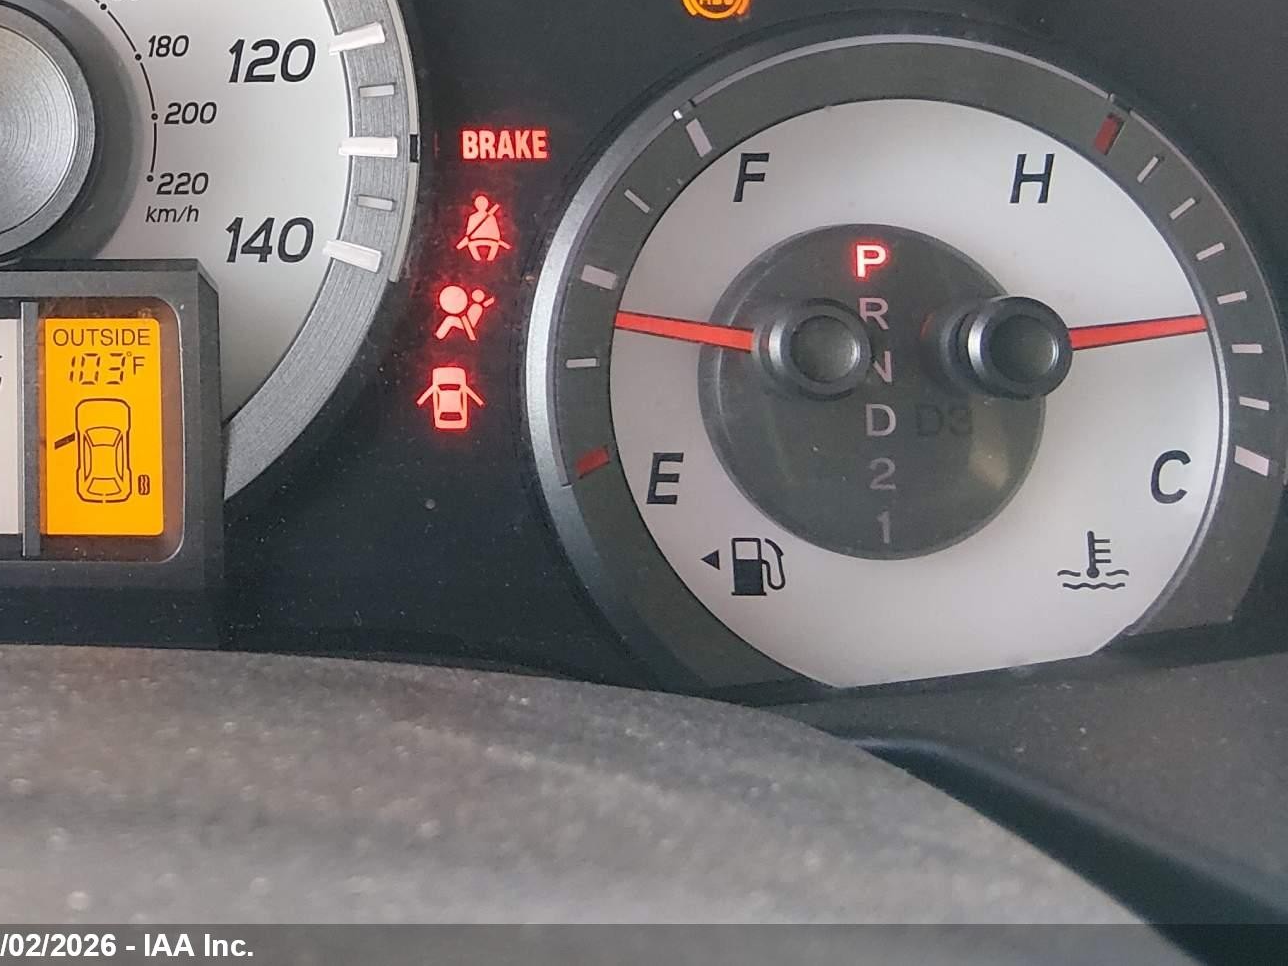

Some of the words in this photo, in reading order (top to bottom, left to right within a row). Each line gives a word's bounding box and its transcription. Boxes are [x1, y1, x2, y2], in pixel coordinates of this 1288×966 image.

[148, 35, 190, 58] 180
[228, 39, 316, 83] 120
[164, 102, 217, 125] 200
[461, 129, 549, 161] BRAKE
[156, 172, 209, 196] 220
[732, 152, 770, 203] F
[1009, 153, 1055, 204] H
[145, 204, 200, 223] km/h
[226, 217, 314, 264] 140
[856, 245, 887, 278] P
[859, 297, 889, 330] R
[52, 328, 151, 346] OUTSIDE
[865, 404, 897, 436] D
[646, 452, 685, 506] E
[869, 457, 897, 490] 2
[1150, 449, 1192, 505] C
[877, 511, 891, 544] 1
